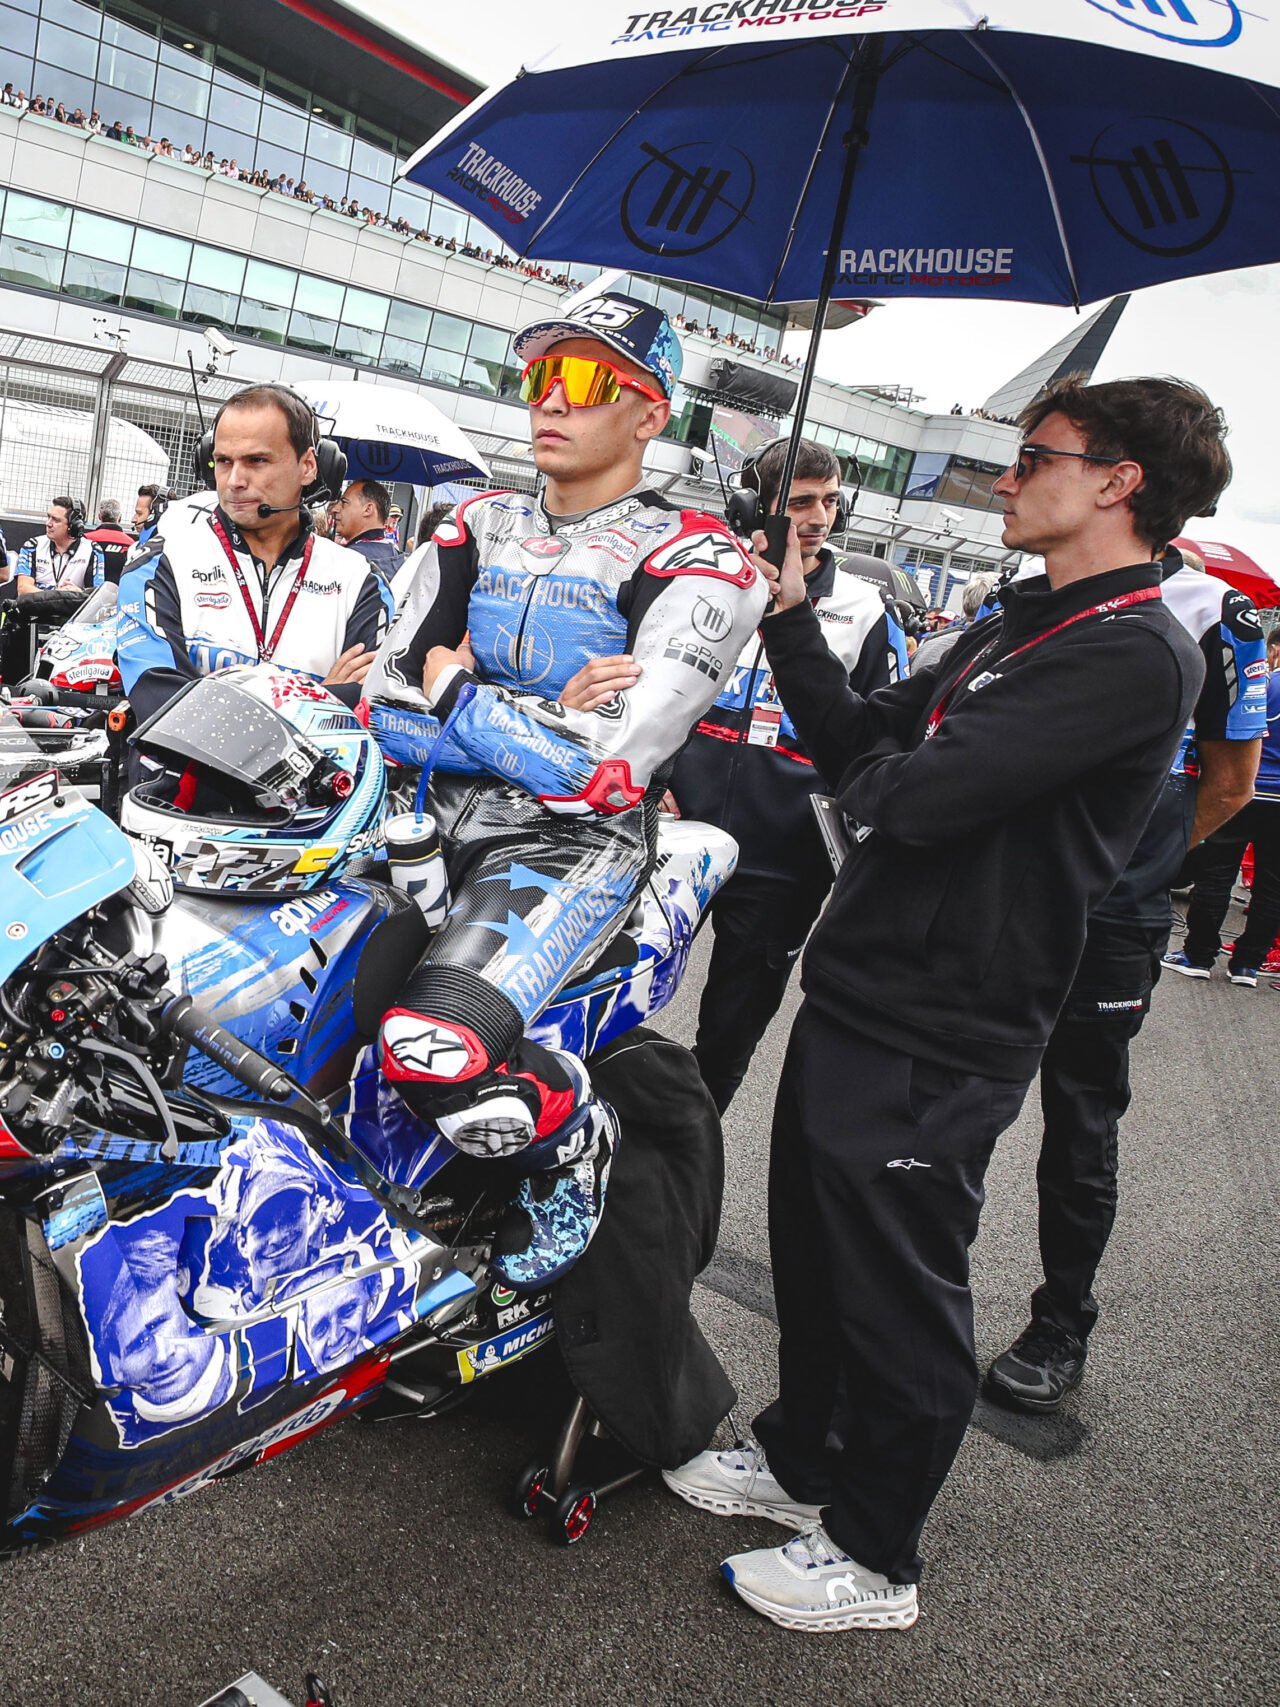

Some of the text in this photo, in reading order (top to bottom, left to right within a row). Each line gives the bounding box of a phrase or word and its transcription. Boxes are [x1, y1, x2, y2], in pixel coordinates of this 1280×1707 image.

[457, 141, 542, 219] TRACKHOUSE
[823, 248, 1014, 274] RACKHOUSE
[832, 273, 905, 286] ACING
[376, 424, 441, 445] TRACKHOUSE
[668, 637, 724, 670] GoPro
[381, 713, 442, 739] TRACKHO
[270, 890, 340, 937] aprilia
[309, 899, 349, 933] RACING
[505, 880, 617, 1008] TRACKHOUSE
[194, 1026, 240, 1066] domino
[497, 1299, 531, 1329] RK
[503, 1318, 555, 1357] MICHE
